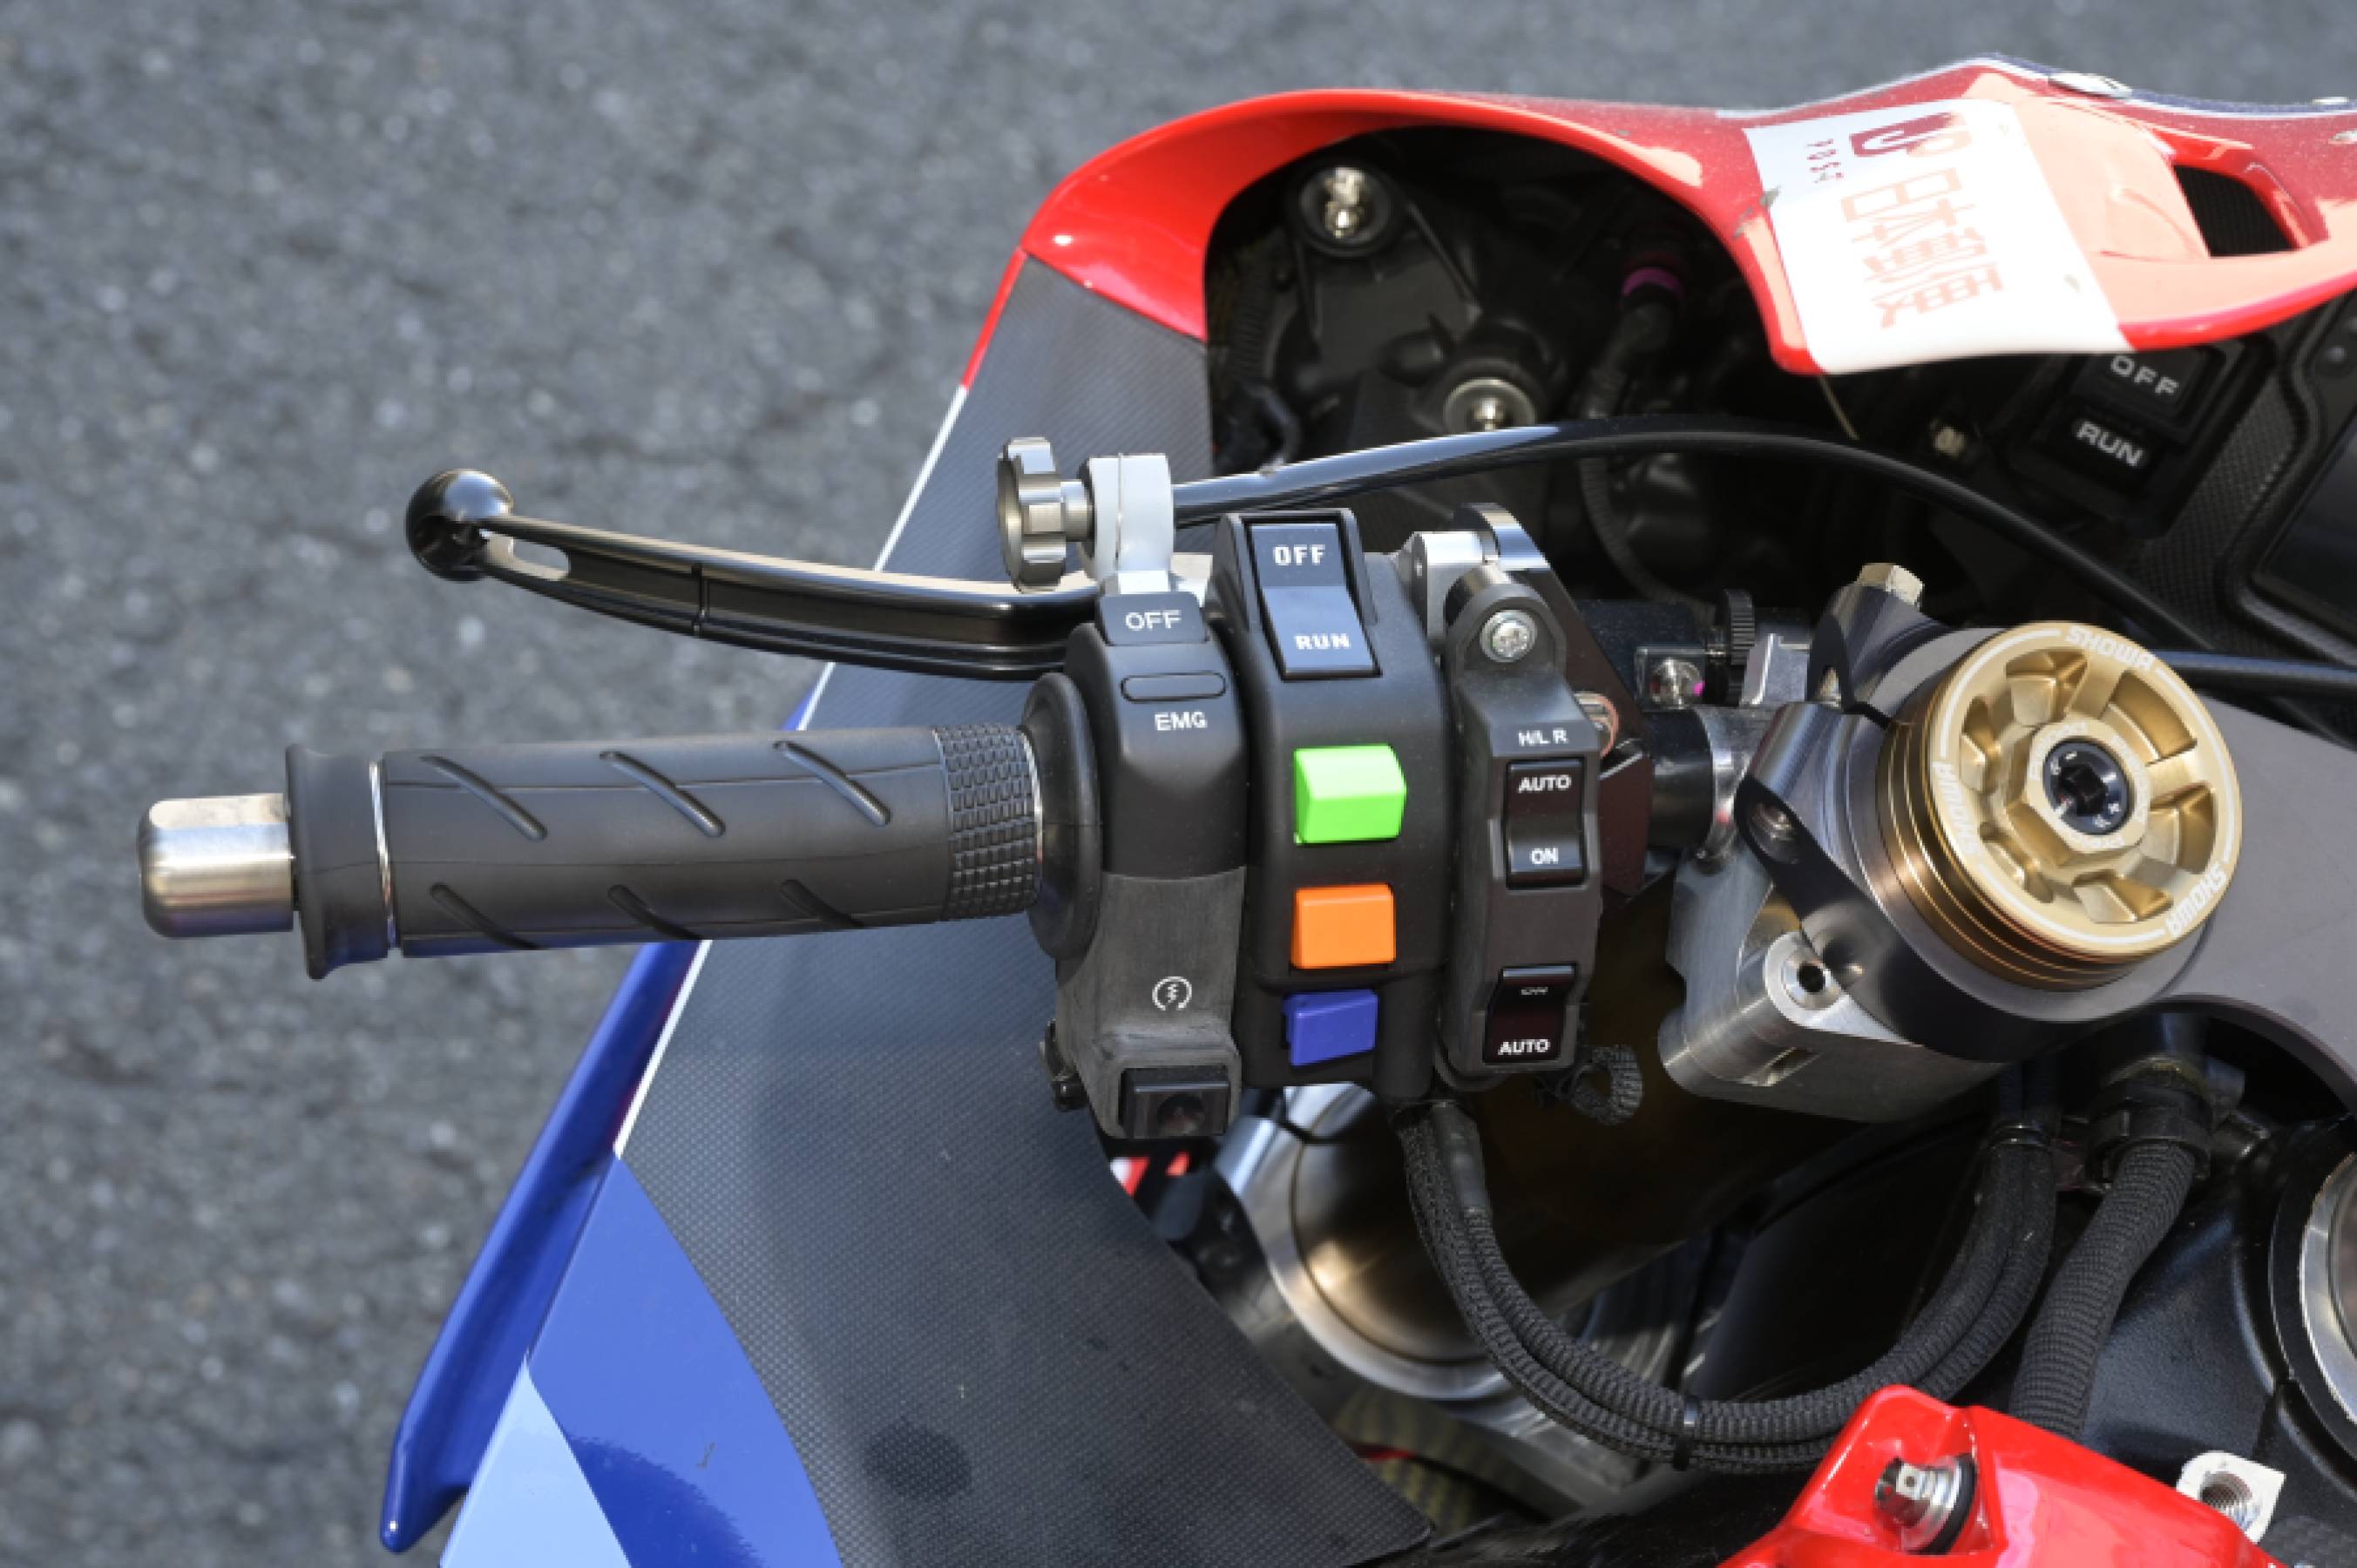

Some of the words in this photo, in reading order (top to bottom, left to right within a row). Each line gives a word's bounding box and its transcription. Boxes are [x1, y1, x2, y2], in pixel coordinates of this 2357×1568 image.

[2110, 355, 2178, 395] OFF
[2076, 421, 2143, 466] RUN
[1272, 544, 1325, 566] OFF
[1124, 609, 1182, 632] OFF
[1294, 632, 1351, 651] RUN
[2064, 625, 2157, 670] SHOWA
[1155, 711, 1208, 732] EMG
[1552, 727, 1568, 745] R
[1517, 774, 1572, 794] AUTO
[1531, 847, 1559, 865] ON
[2166, 862, 2226, 937] SHOWA
[1498, 1038, 1551, 1056] AUTO
